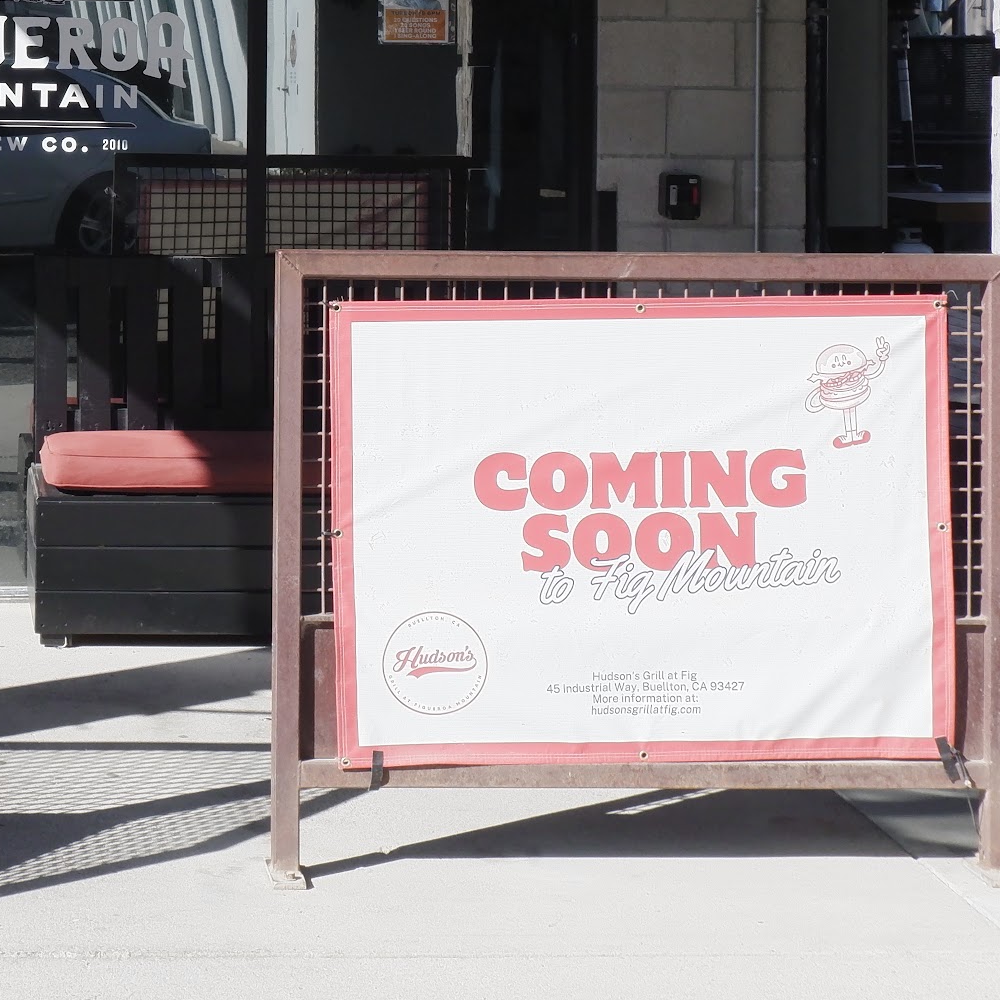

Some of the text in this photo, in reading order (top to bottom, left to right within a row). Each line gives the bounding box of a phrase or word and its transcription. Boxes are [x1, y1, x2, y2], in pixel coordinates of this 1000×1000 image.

[41, 136, 89, 154] CO.
[102, 138, 129, 151] 2010
[474, 448, 807, 511] COMING
[522, 511, 757, 573] SOON
[539, 547, 842, 614] to Fig Mountain
[393, 645, 477, 673] Hudson's
[592, 670, 698, 682] Hudson's Grill at Fig
[546, 684, 561, 694] 45
[563, 683, 612, 693] Industrial
[642, 682, 690, 693] Buellton,
[691, 682, 708, 692] CA
[710, 681, 745, 691] 93427
[592, 693, 699, 704] More information at:
[591, 705, 702, 716] hudsonsgrillatfig.com
